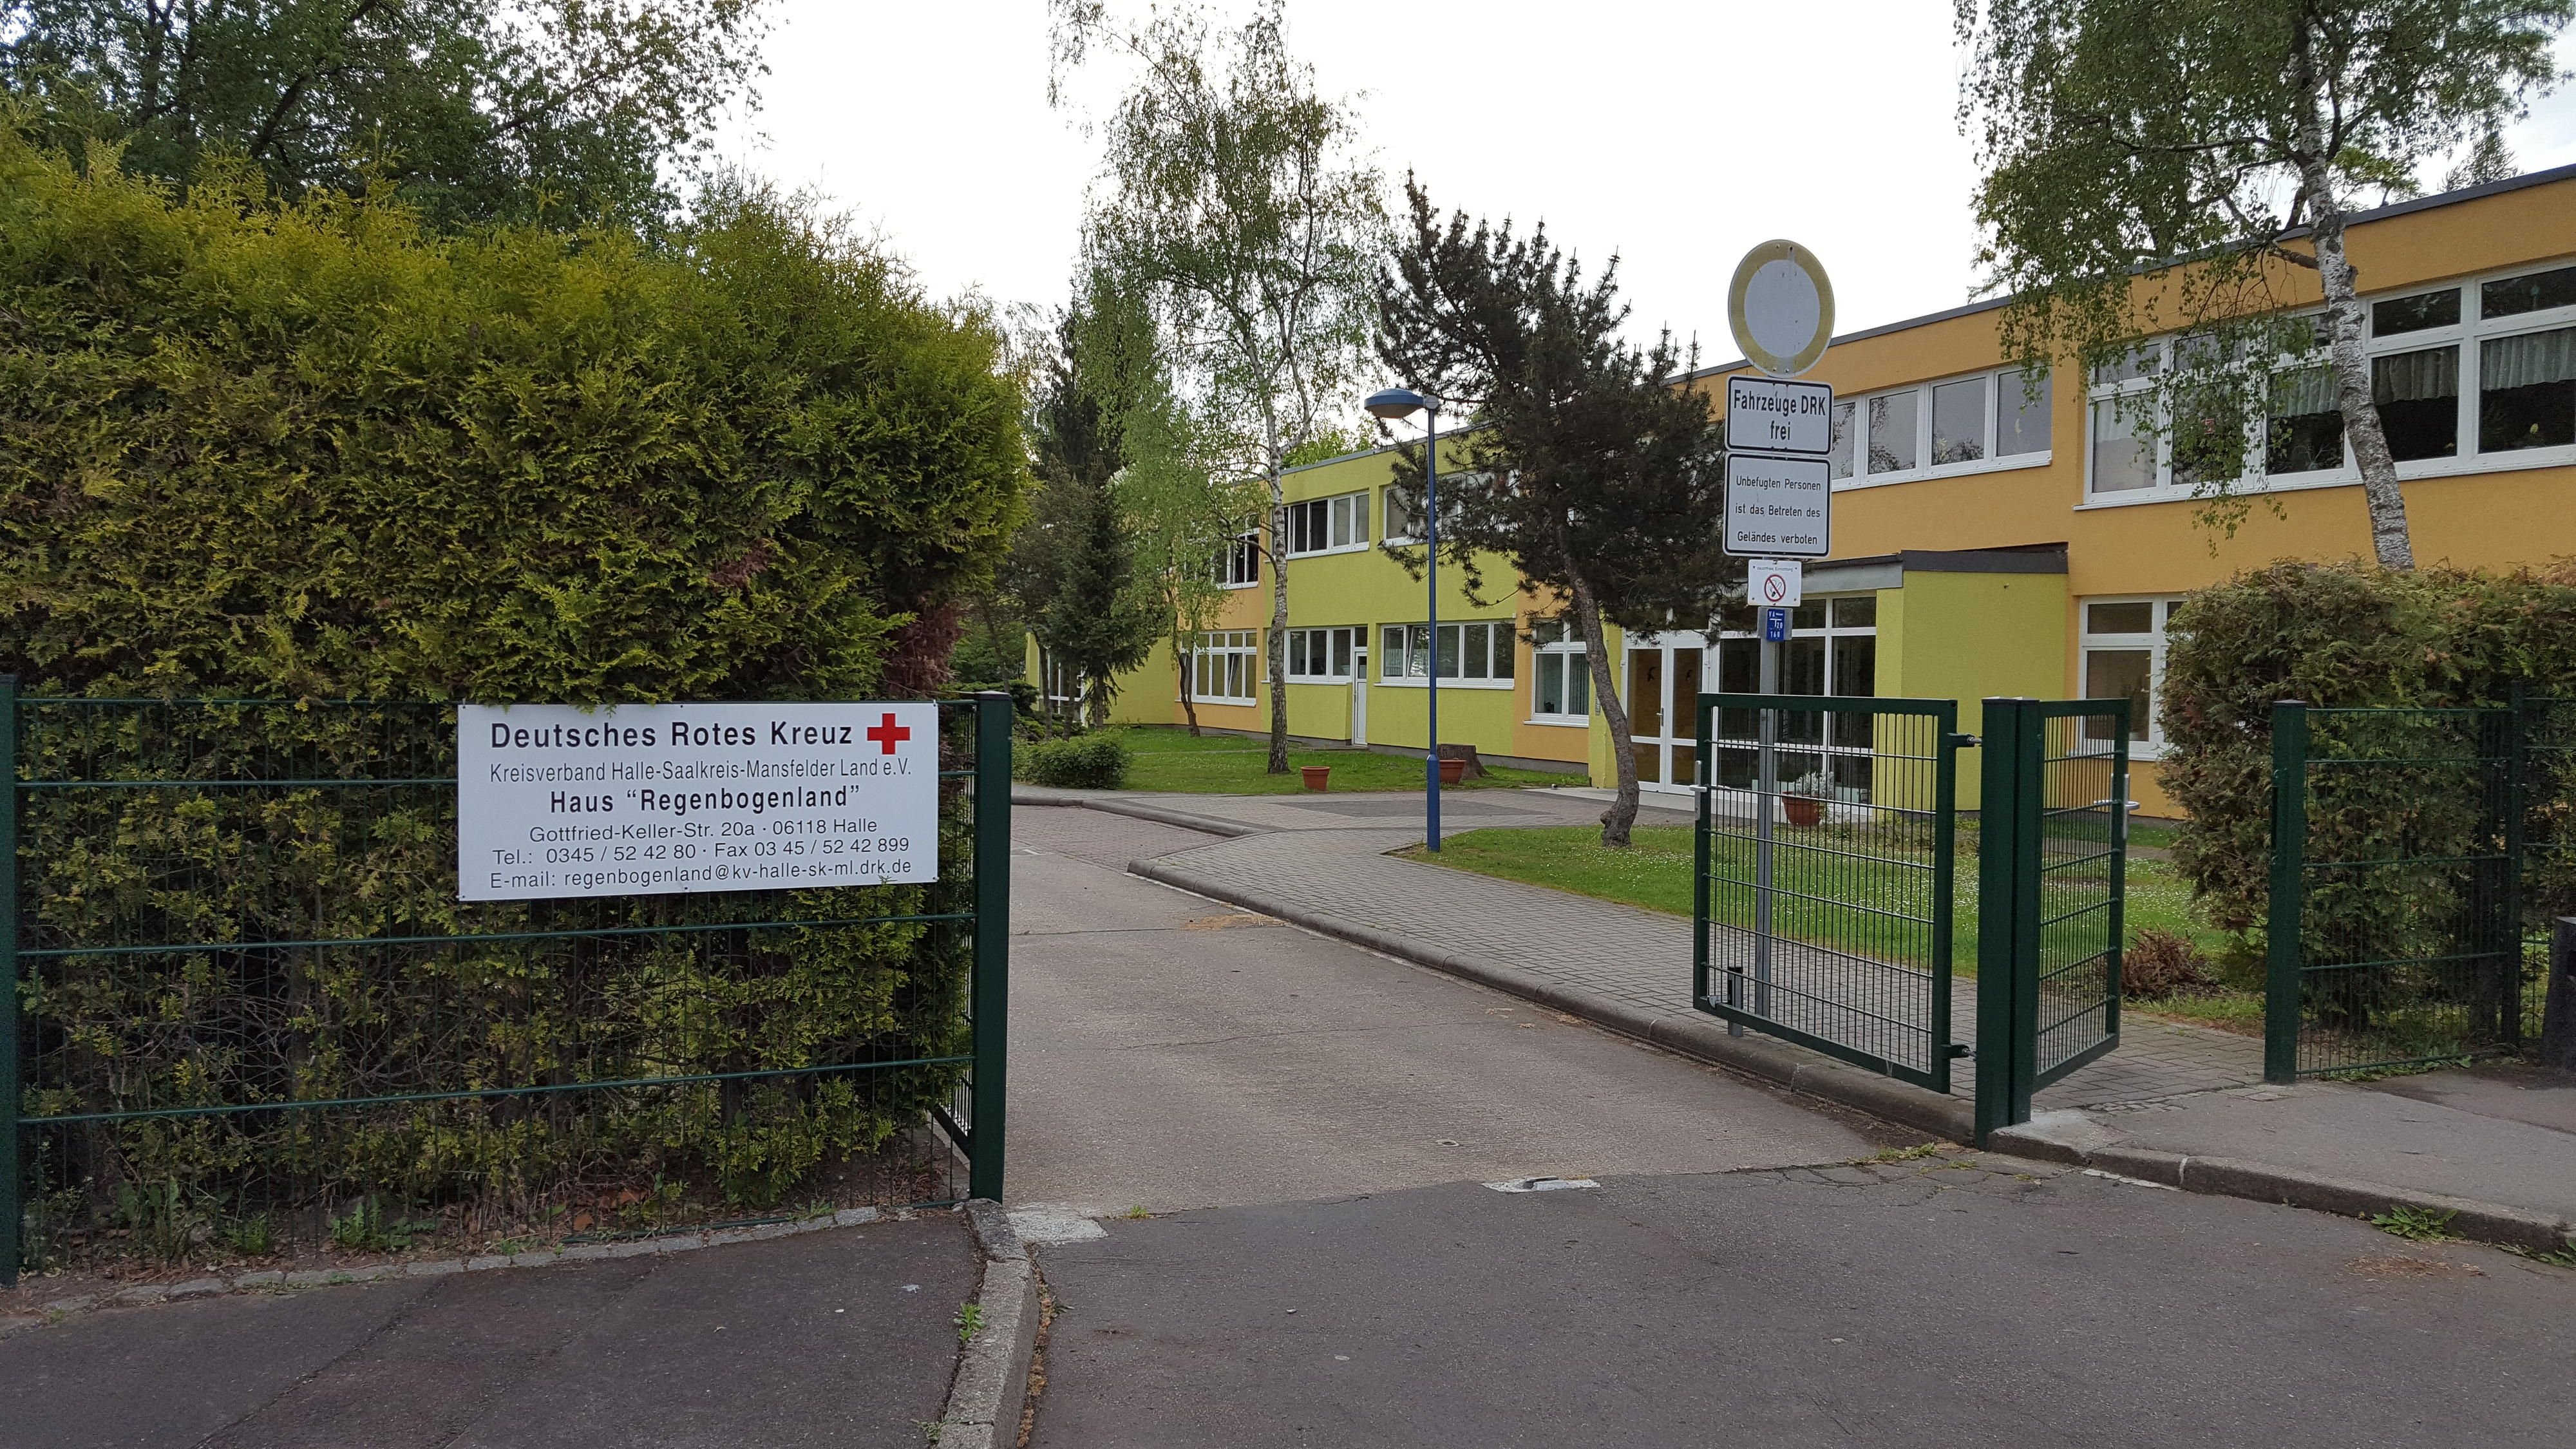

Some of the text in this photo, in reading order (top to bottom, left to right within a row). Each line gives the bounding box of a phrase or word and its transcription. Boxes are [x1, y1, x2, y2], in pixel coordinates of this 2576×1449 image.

[1734, 389, 1826, 417] Fahrzeuge DRK
[1770, 420, 1791, 440] frei
[1736, 475, 1821, 491] Unbefugten Personen
[1735, 502, 1821, 518] ist das Betreten des
[1737, 531, 1817, 545] Geländes verboten
[491, 721, 852, 748] Deutsches Rotes Kreuz
[491, 757, 911, 782] Kreisverband Halle-Saalkreis-Mansfelder Land e.V.
[551, 790, 614, 813] Haus
[529, 822, 714, 842] Gottfried-Keller-Str.
[721, 821, 755, 837] 20a
[773, 819, 827, 835] 06118
[833, 818, 877, 833] Halle
[491, 849, 532, 865] Tel.:
[546, 847, 594, 864] 0345
[600, 846, 607, 862] /
[613, 846, 636, 861] 52
[643, 845, 667, 860] 42
[673, 844, 696, 859] 80
[715, 842, 748, 858] Fax
[754, 841, 777, 857] 03
[782, 840, 804, 855] 45
[810, 839, 817, 855] /
[822, 839, 844, 854] 52
[849, 838, 871, 853] 42
[877, 837, 909, 853] 899
[491, 858, 912, 889] E-mail: regenbogenland@kv-halle-sk-ml.drk.de
